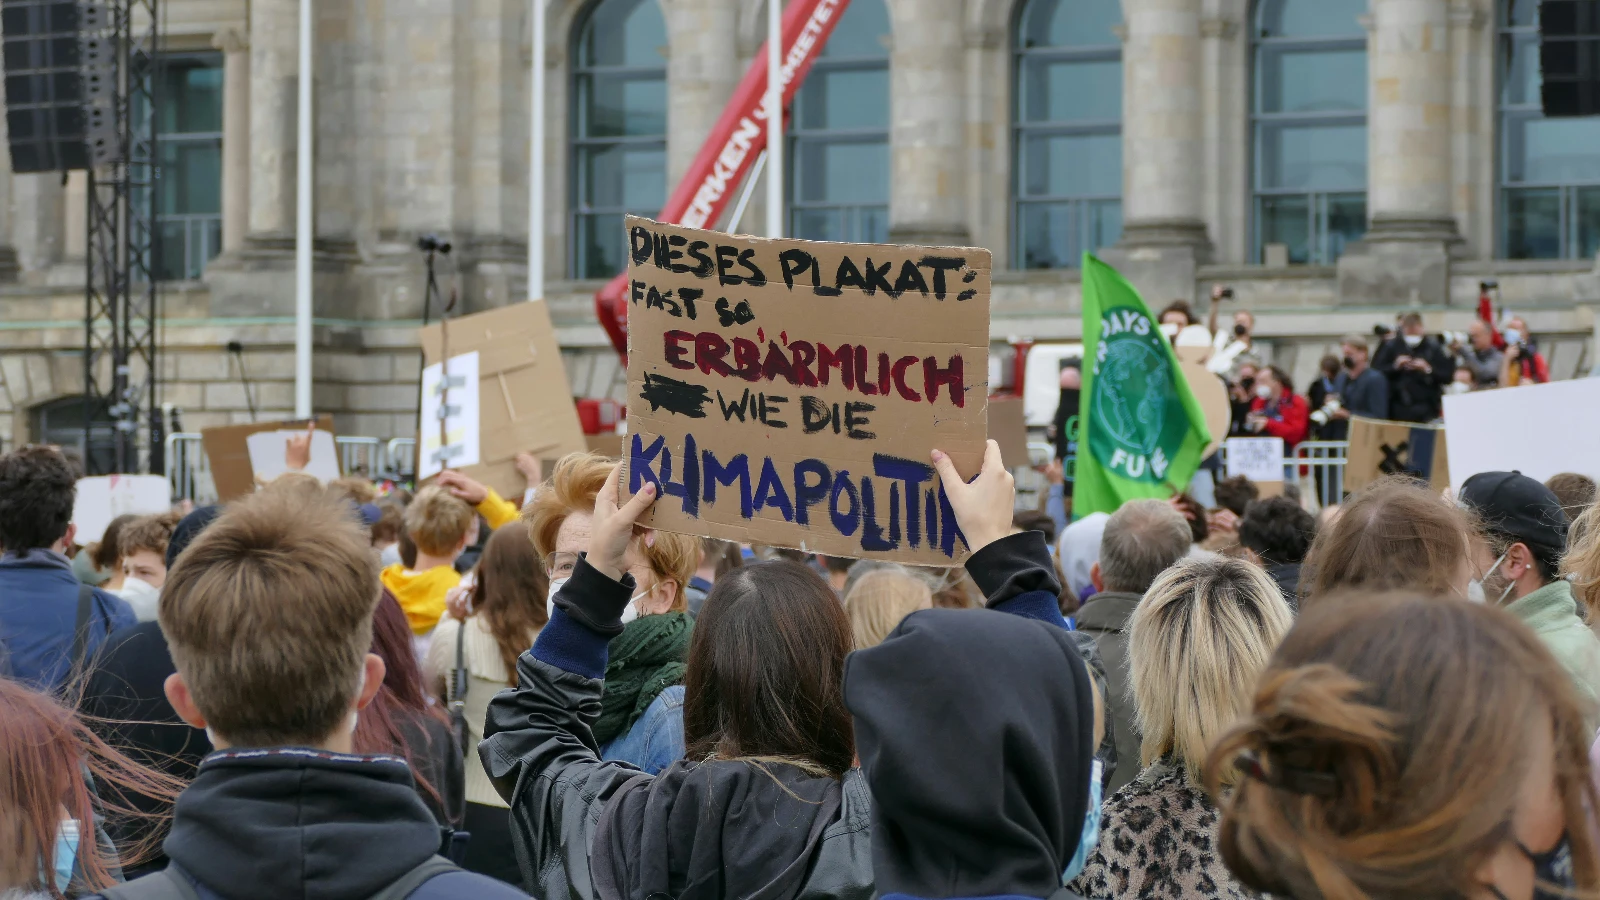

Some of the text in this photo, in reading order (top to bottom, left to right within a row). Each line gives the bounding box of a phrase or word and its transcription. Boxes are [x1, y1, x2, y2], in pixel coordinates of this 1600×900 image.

[630, 226, 978, 301] DIESES PLAKAT:
[631, 280, 704, 320] FAST
[663, 327, 965, 408] ERBÄRMLICH
[716, 388, 877, 440] WIE DIE
